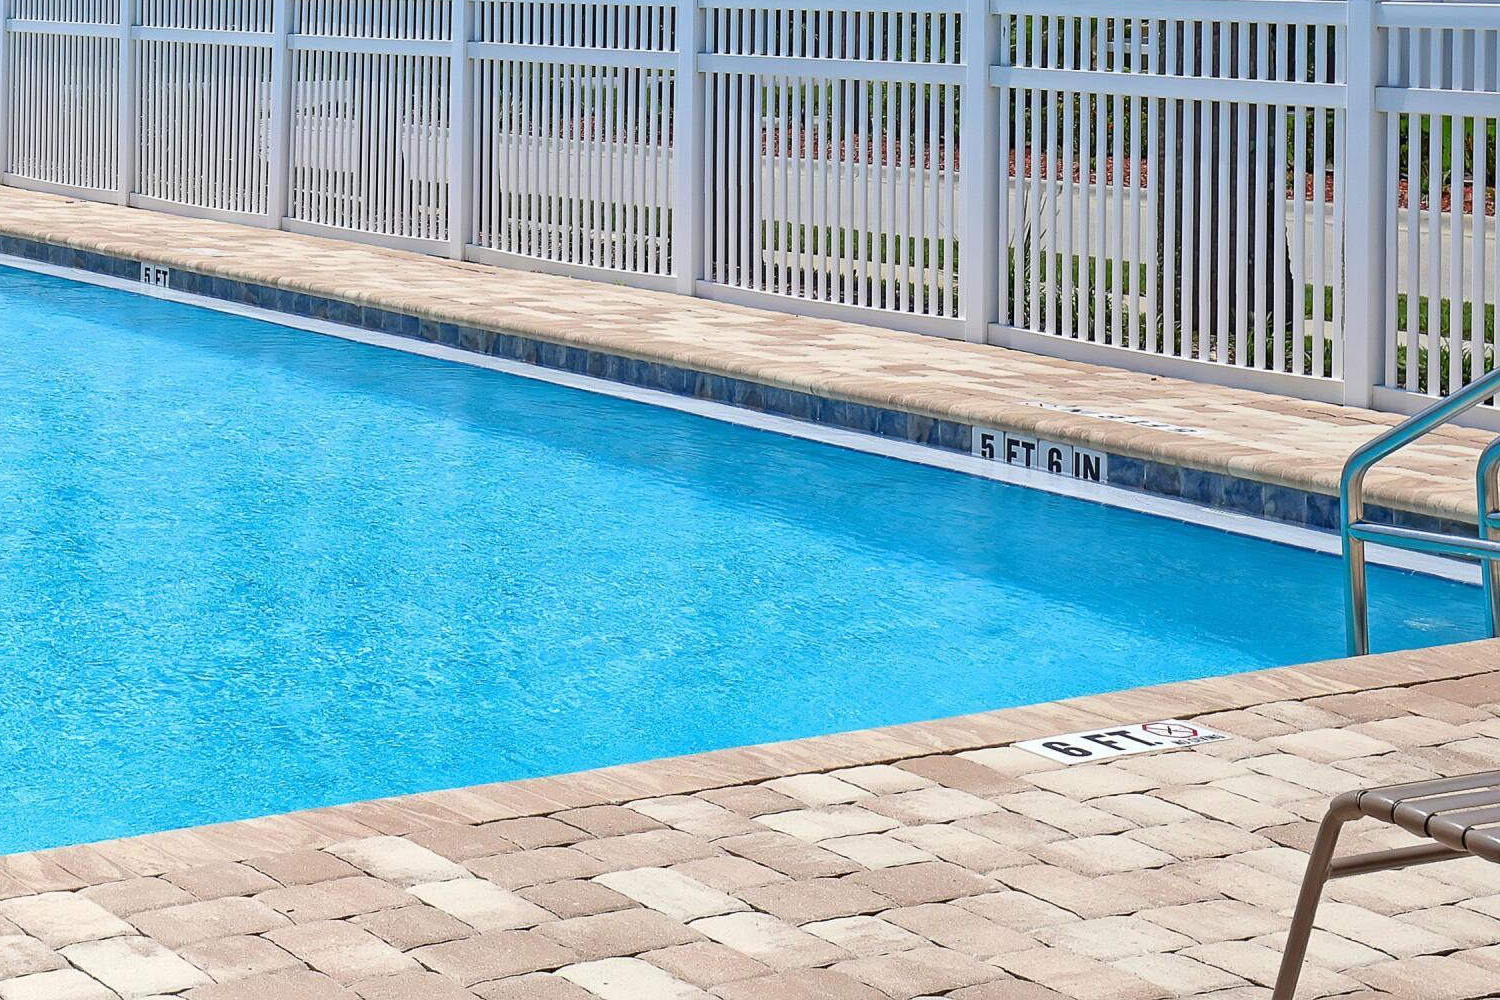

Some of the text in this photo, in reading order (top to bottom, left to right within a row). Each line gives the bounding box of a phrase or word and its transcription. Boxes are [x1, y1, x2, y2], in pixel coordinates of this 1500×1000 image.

[144, 266, 168, 288] 5 FT
[980, 432, 1101, 481] 5 FT 6 IN
[1042, 740, 1093, 758] 6
